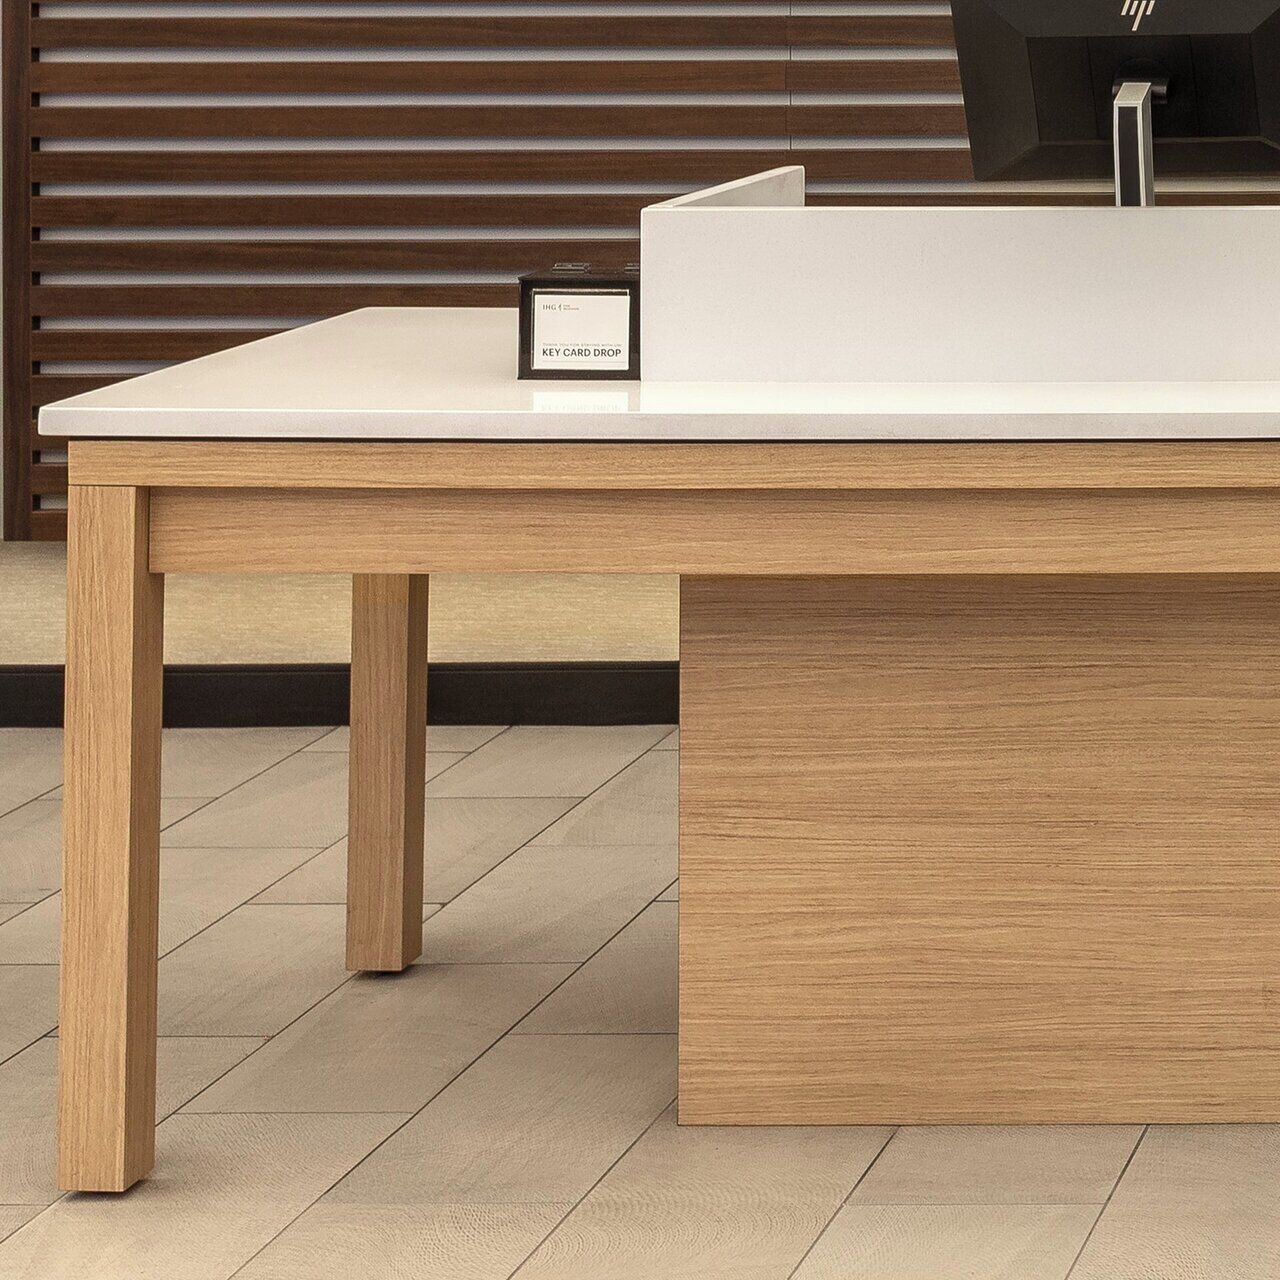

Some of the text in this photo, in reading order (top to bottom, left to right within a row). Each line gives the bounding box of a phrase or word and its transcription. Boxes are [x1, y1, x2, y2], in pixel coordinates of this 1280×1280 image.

[542, 348, 622, 357] KEY CARD DROP
